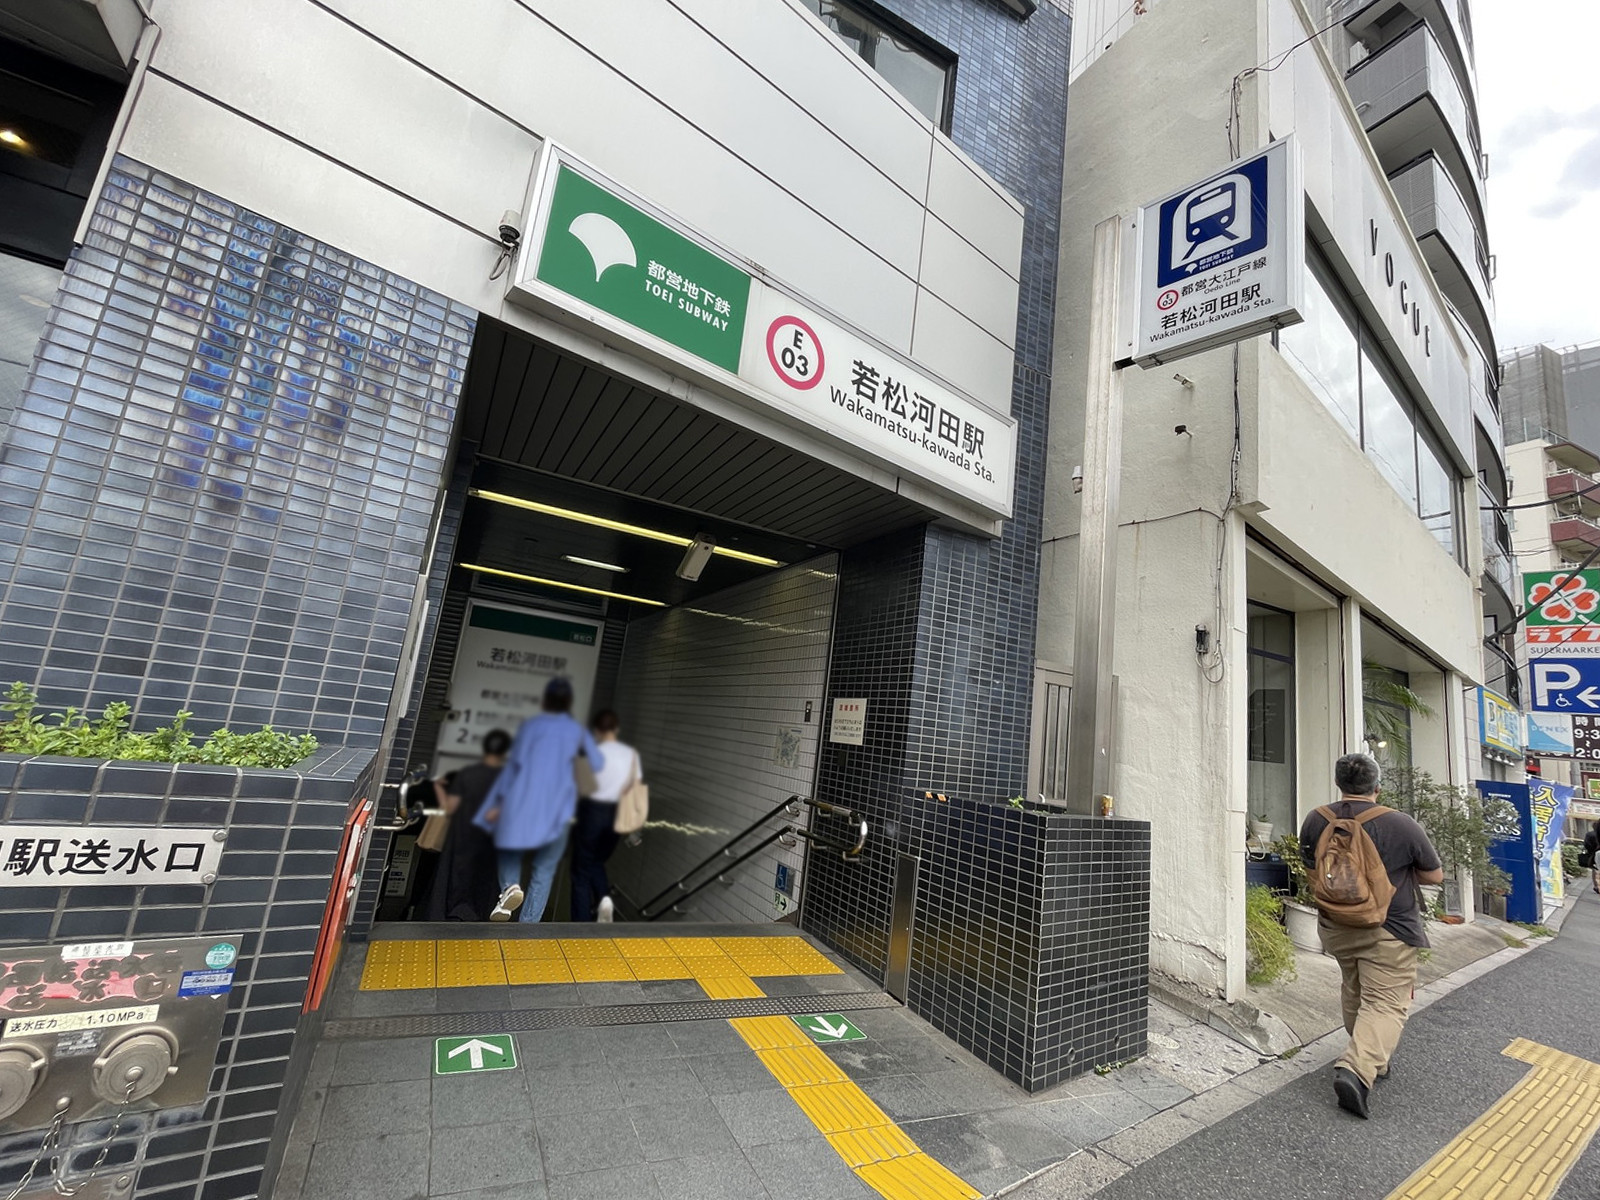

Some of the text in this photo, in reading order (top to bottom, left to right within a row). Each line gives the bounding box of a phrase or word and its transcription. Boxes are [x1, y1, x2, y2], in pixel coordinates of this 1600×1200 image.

[647, 259, 732, 318] 都営地下鉄
[1181, 256, 1268, 298] 都営大江戸線
[1203, 277, 1242, 296] Oedo Line
[644, 279, 729, 332] TOEI SUBWAY
[1150, 298, 1275, 344] Wakamatsu-kawada Sta.
[1160, 282, 1262, 331] 若松河田駅
[793, 329, 804, 350] E
[781, 347, 810, 377] 03
[851, 358, 986, 460] 若松河田駅
[829, 385, 997, 485] Wakamatsu-kawada Sta.
[1534, 664, 1581, 707] P
[0, 838, 206, 877] 駅送水口
[9, 1018, 58, 1034] 送水圧力
[86, 1010, 145, 1028] 1.10MPa
